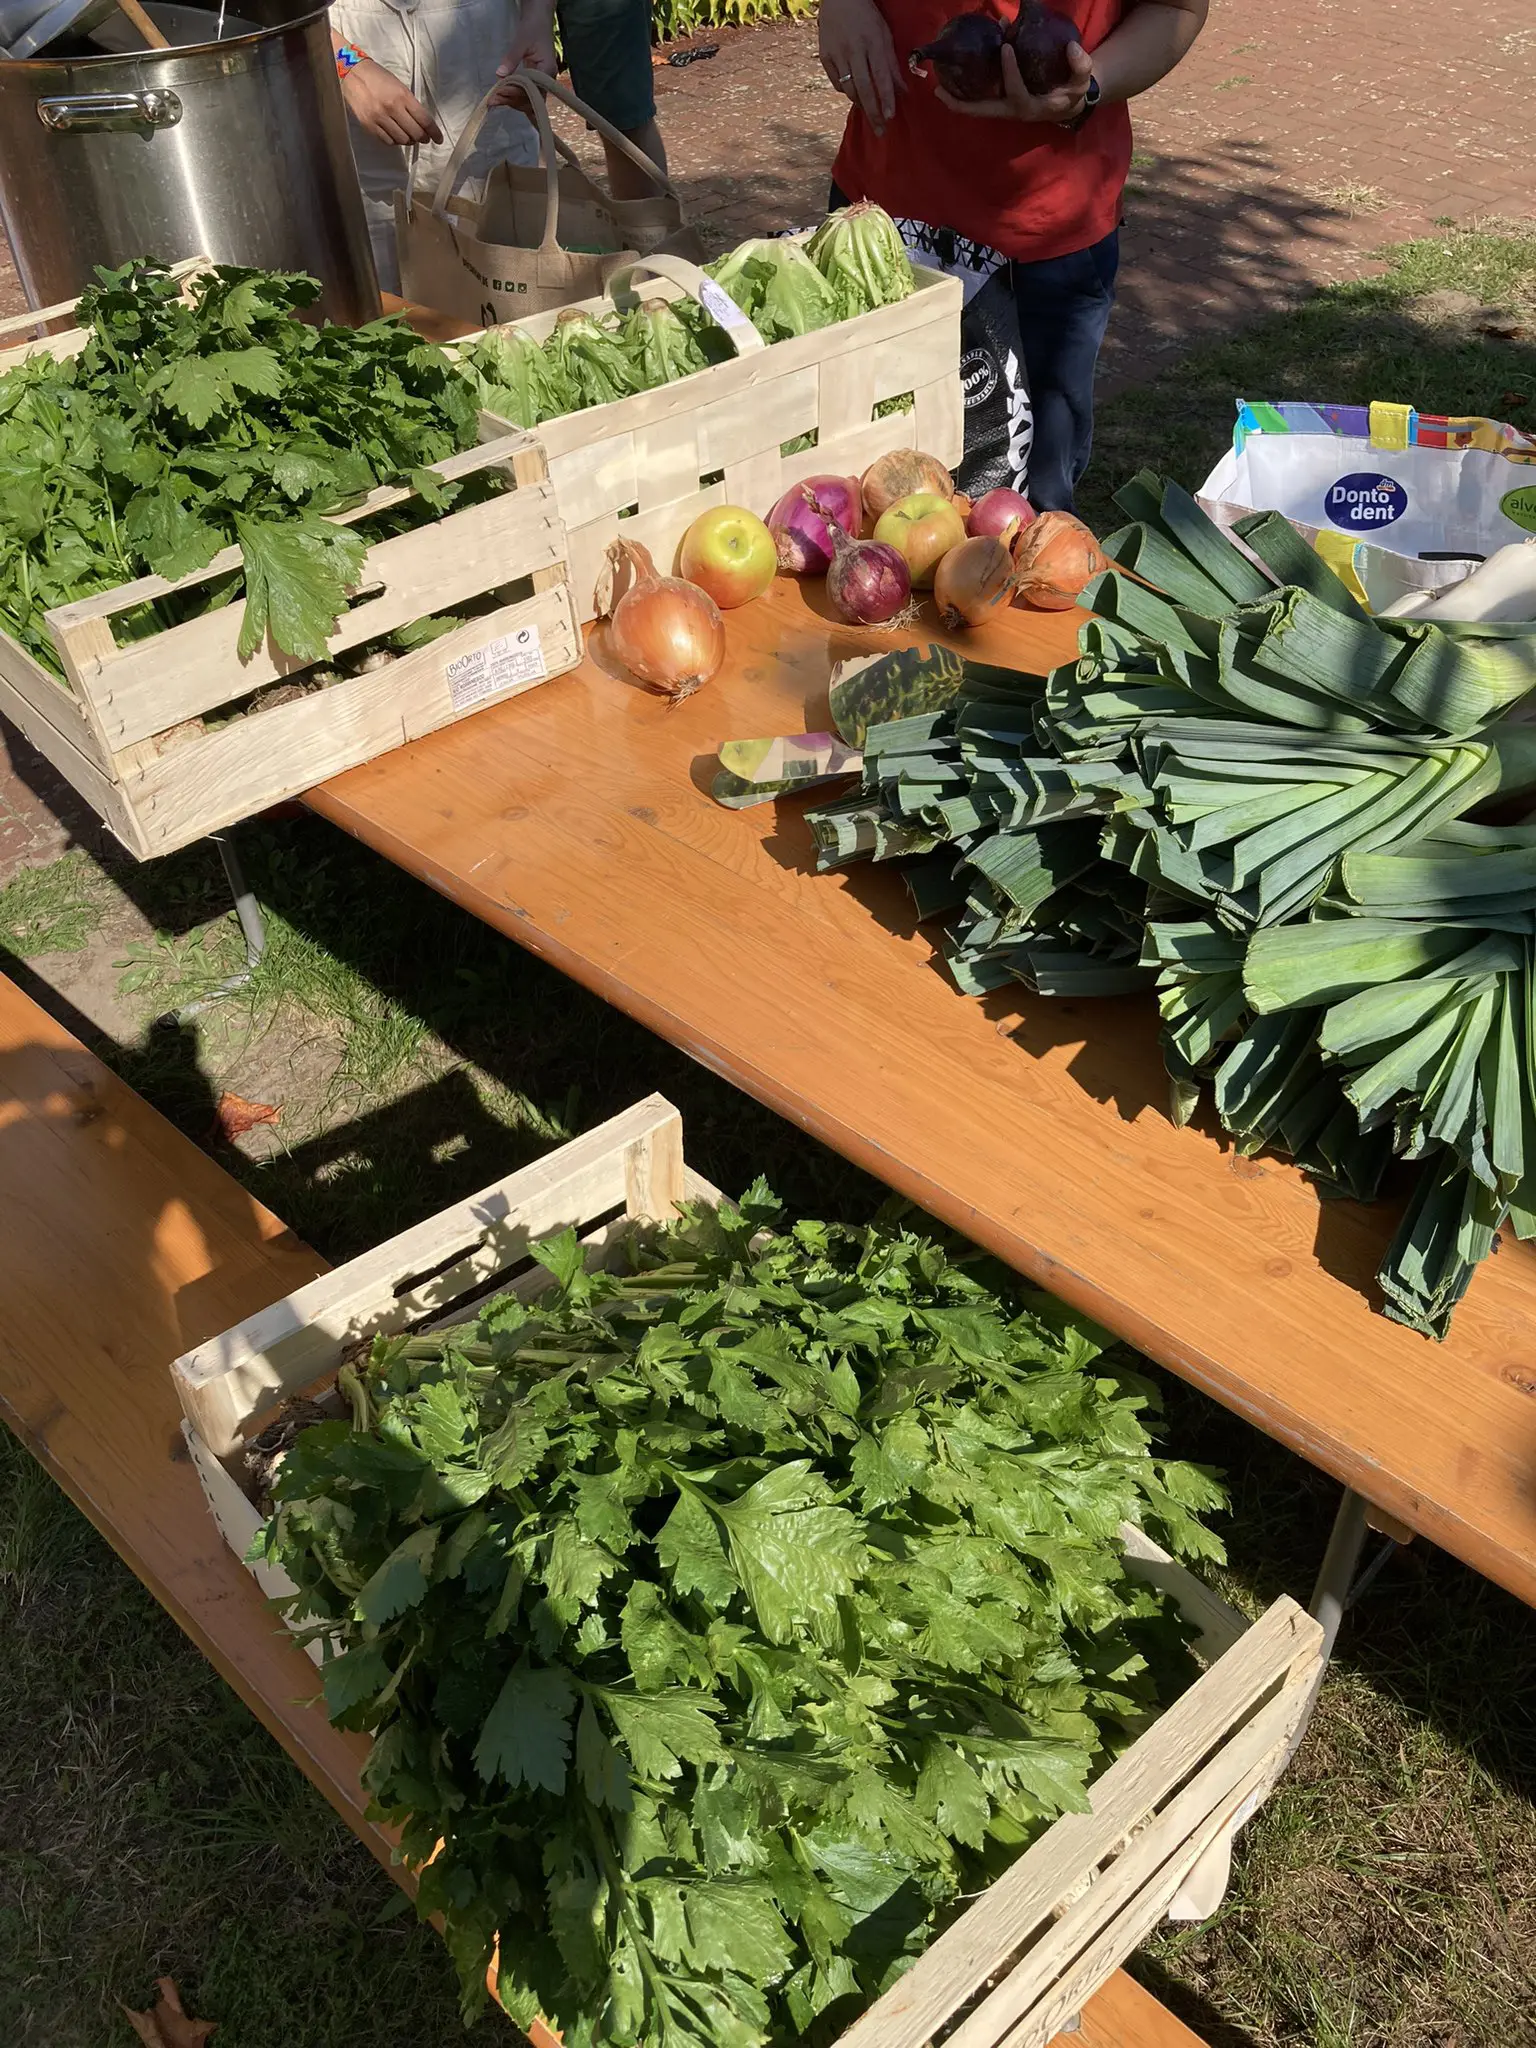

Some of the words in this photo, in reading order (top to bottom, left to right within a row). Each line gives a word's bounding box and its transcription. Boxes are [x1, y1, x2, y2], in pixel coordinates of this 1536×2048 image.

[964, 365, 989, 391] 00%
[1332, 486, 1390, 504] Donto
[1350, 503, 1395, 520] dent
[1510, 498, 1536, 513] alv
